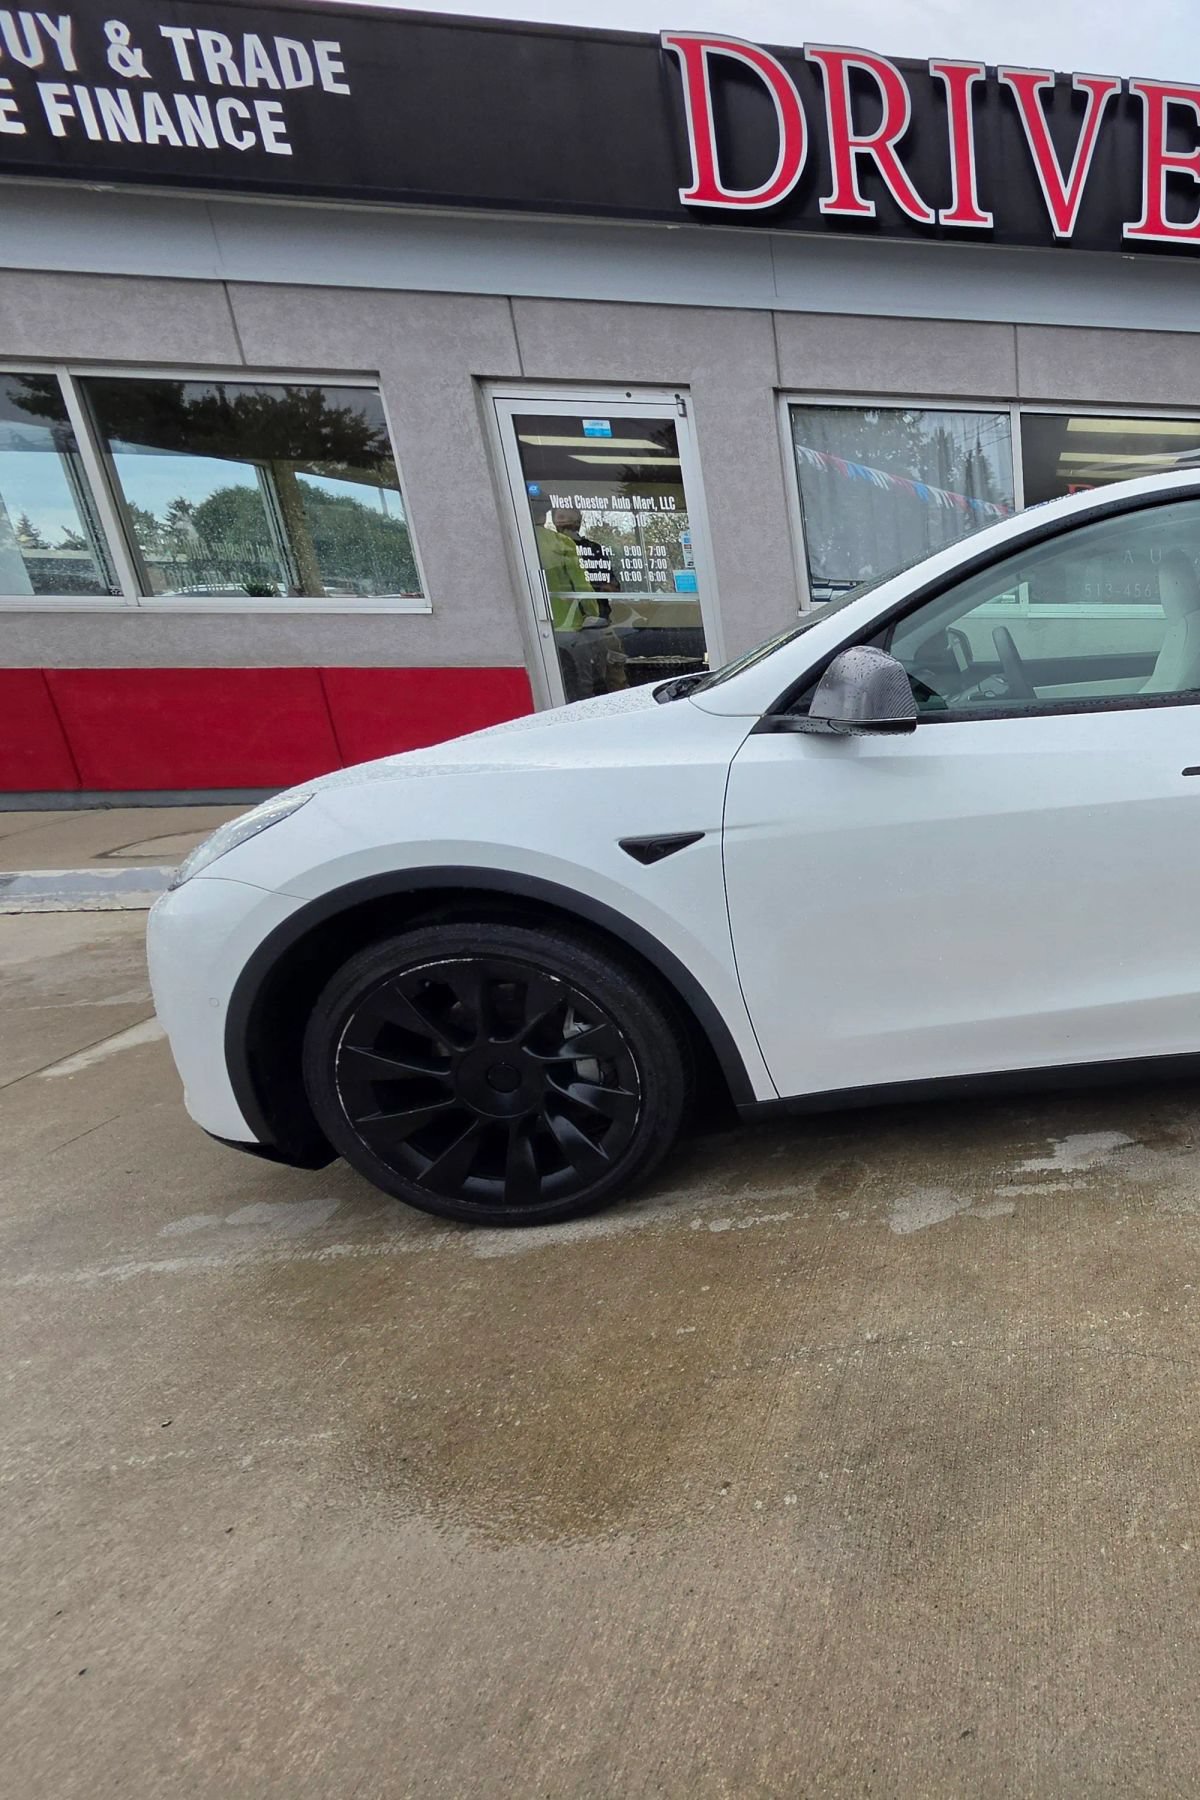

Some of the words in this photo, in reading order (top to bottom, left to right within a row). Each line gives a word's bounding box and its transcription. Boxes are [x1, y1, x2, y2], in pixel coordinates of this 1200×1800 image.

[0, 8, 78, 72] UY
[104, 19, 152, 78] &
[159, 24, 350, 96] TRADE
[36, 82, 293, 156] FINANCE
[549, 494, 573, 509] West
[573, 494, 609, 509] Chester
[611, 495, 631, 509] Auto
[632, 495, 658, 511] Mart,
[659, 496, 676, 510] LLC
[575, 545, 595, 556] Mon.
[601, 545, 616, 556] Fri.
[623, 545, 642, 557] 9:00
[648, 545, 667, 557] 7:00
[578, 558, 612, 571] Saturday
[620, 558, 643, 569] 10:00
[648, 558, 668, 569] 7:00
[584, 570, 611, 584] Sunday
